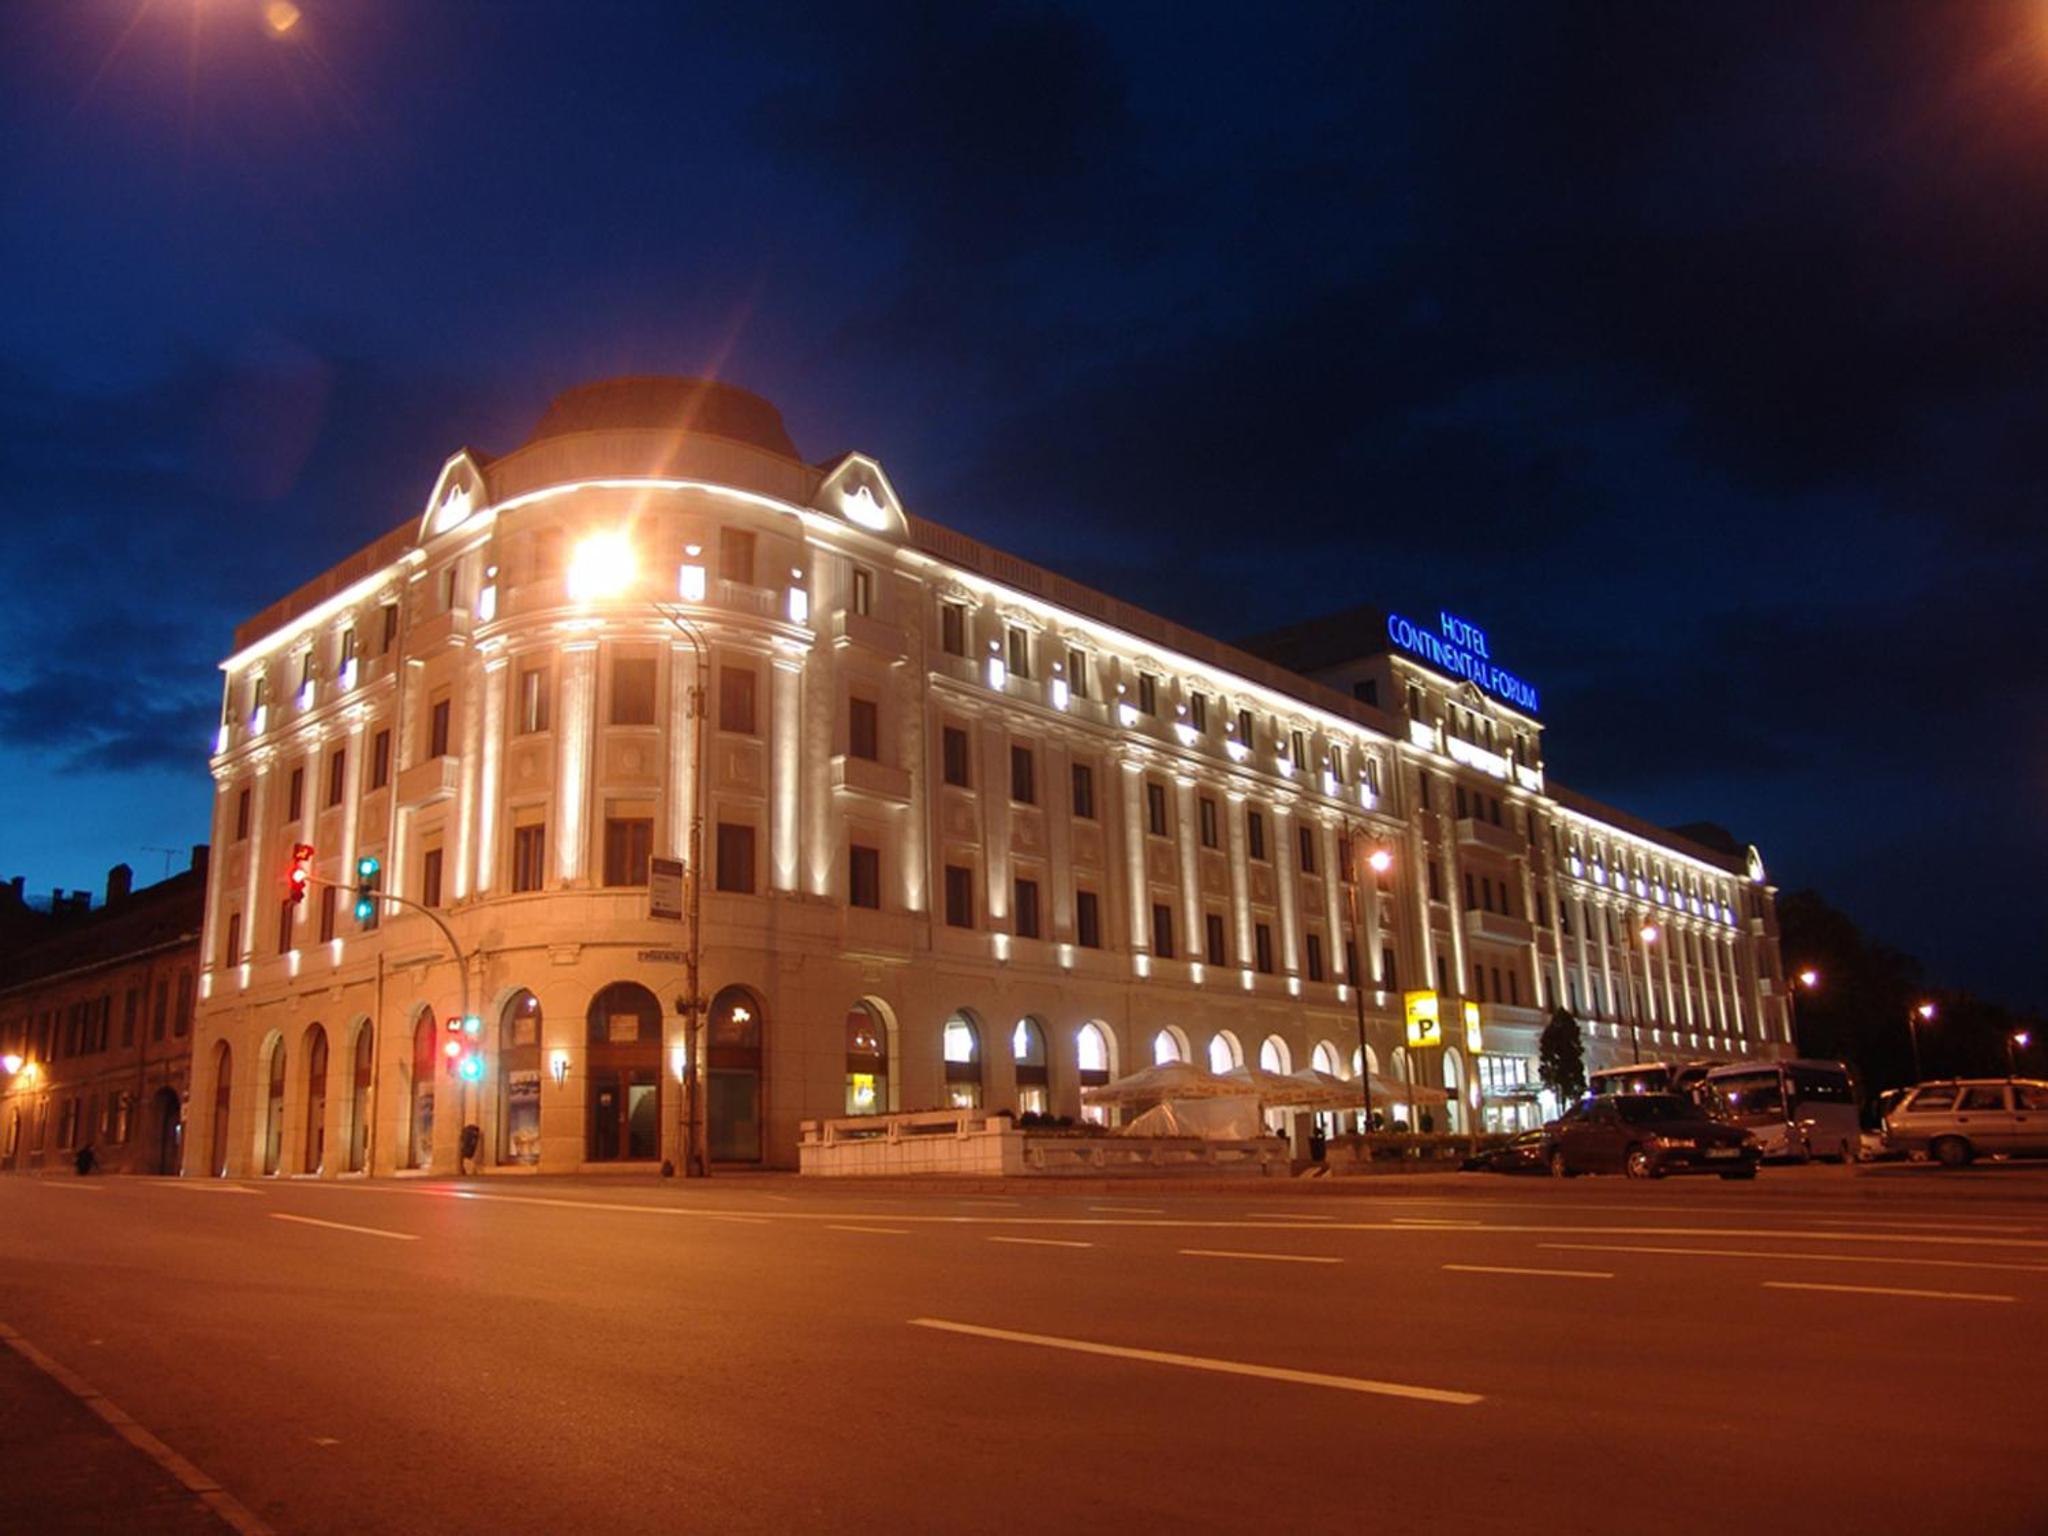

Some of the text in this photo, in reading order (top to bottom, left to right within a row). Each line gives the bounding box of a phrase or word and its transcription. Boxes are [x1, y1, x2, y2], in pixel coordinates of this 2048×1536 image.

[1440, 610, 1489, 660] HOTEL
[1387, 613, 1538, 712] CONTINENTAL FORUM
[1418, 1018, 1434, 1040] P
